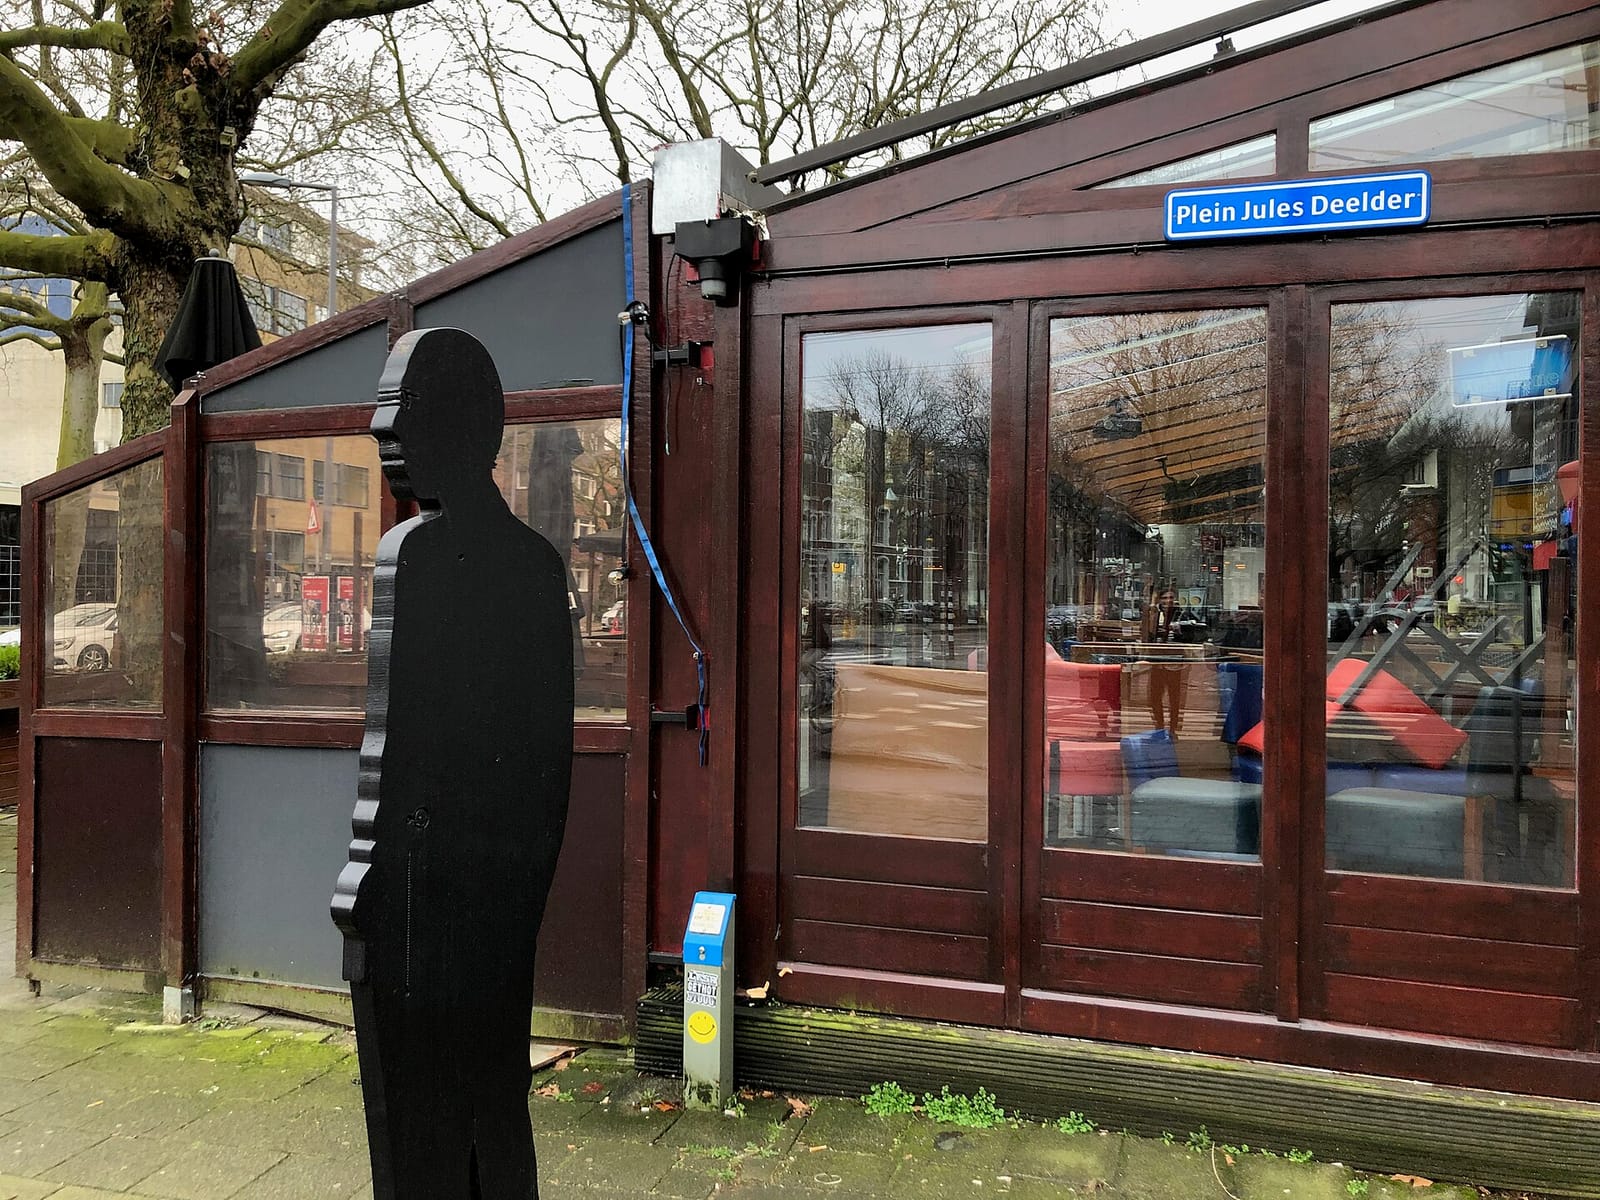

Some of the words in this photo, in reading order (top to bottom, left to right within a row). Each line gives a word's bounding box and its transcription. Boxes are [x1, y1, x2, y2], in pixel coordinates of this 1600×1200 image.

[1176, 202, 1236, 225] Plein
[1240, 198, 1304, 221] Jules
[1311, 189, 1417, 216] Deelder
